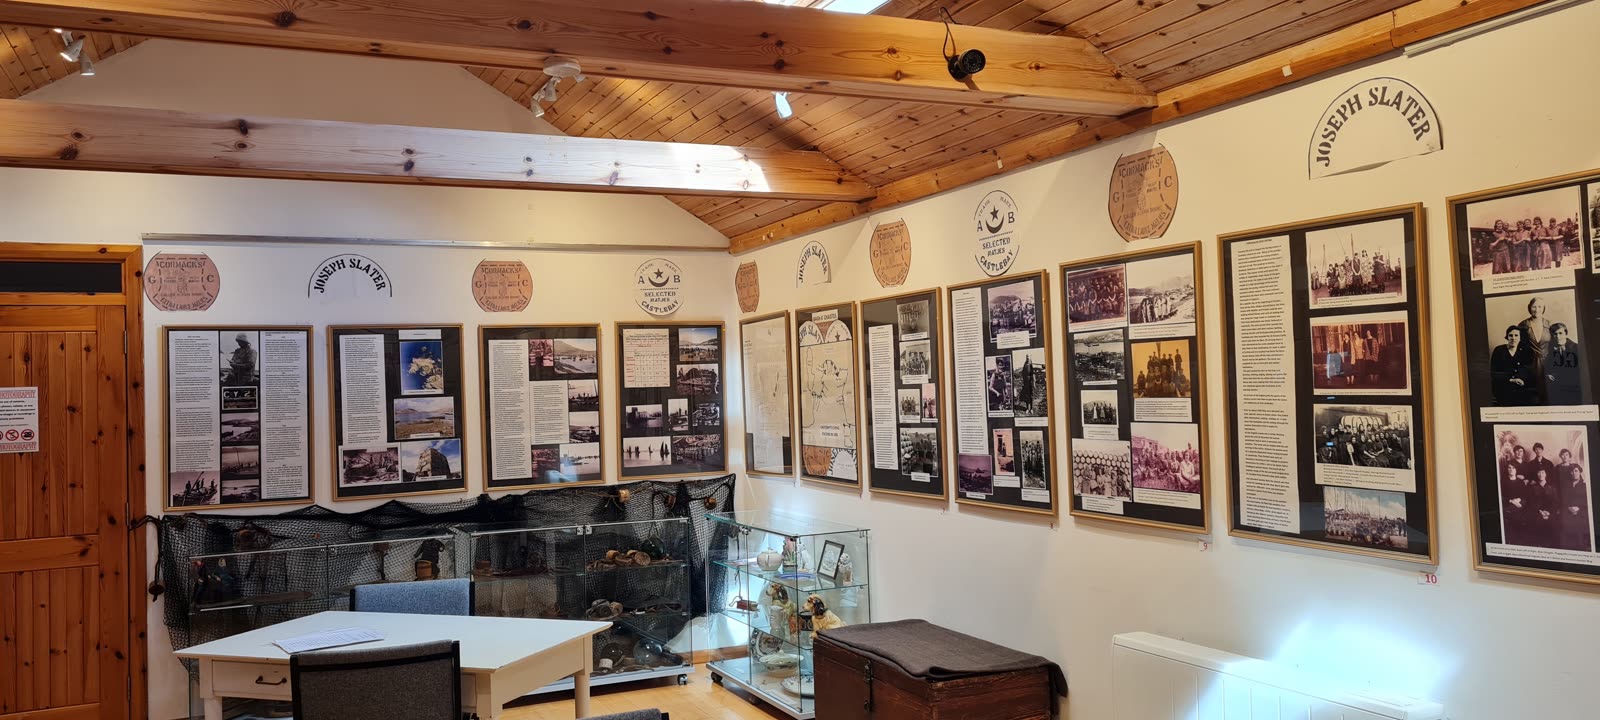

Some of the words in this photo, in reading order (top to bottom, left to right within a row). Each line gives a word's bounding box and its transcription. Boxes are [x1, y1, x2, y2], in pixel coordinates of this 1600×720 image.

[1316, 94, 1362, 167] JOSEPH
[1368, 86, 1430, 141] SLATER
[1164, 176, 1172, 188] C
[1113, 192, 1120, 203] G
[1008, 211, 1015, 224] B
[977, 220, 983, 232] A
[904, 242, 908, 250] C
[982, 237, 1010, 250] SELECTED
[873, 250, 878, 258] G
[799, 248, 811, 283] JOSEPH
[812, 246, 827, 275] SLATER
[980, 249, 1013, 272] CASTLEBAY
[148, 276, 156, 284] G
[314, 259, 346, 294] JOSEPH
[349, 258, 386, 291] SLATER
[638, 276, 645, 284] A
[674, 275, 680, 283] B
[641, 300, 678, 313] CASTLEBAY
[1425, 574, 1437, 584] 10
